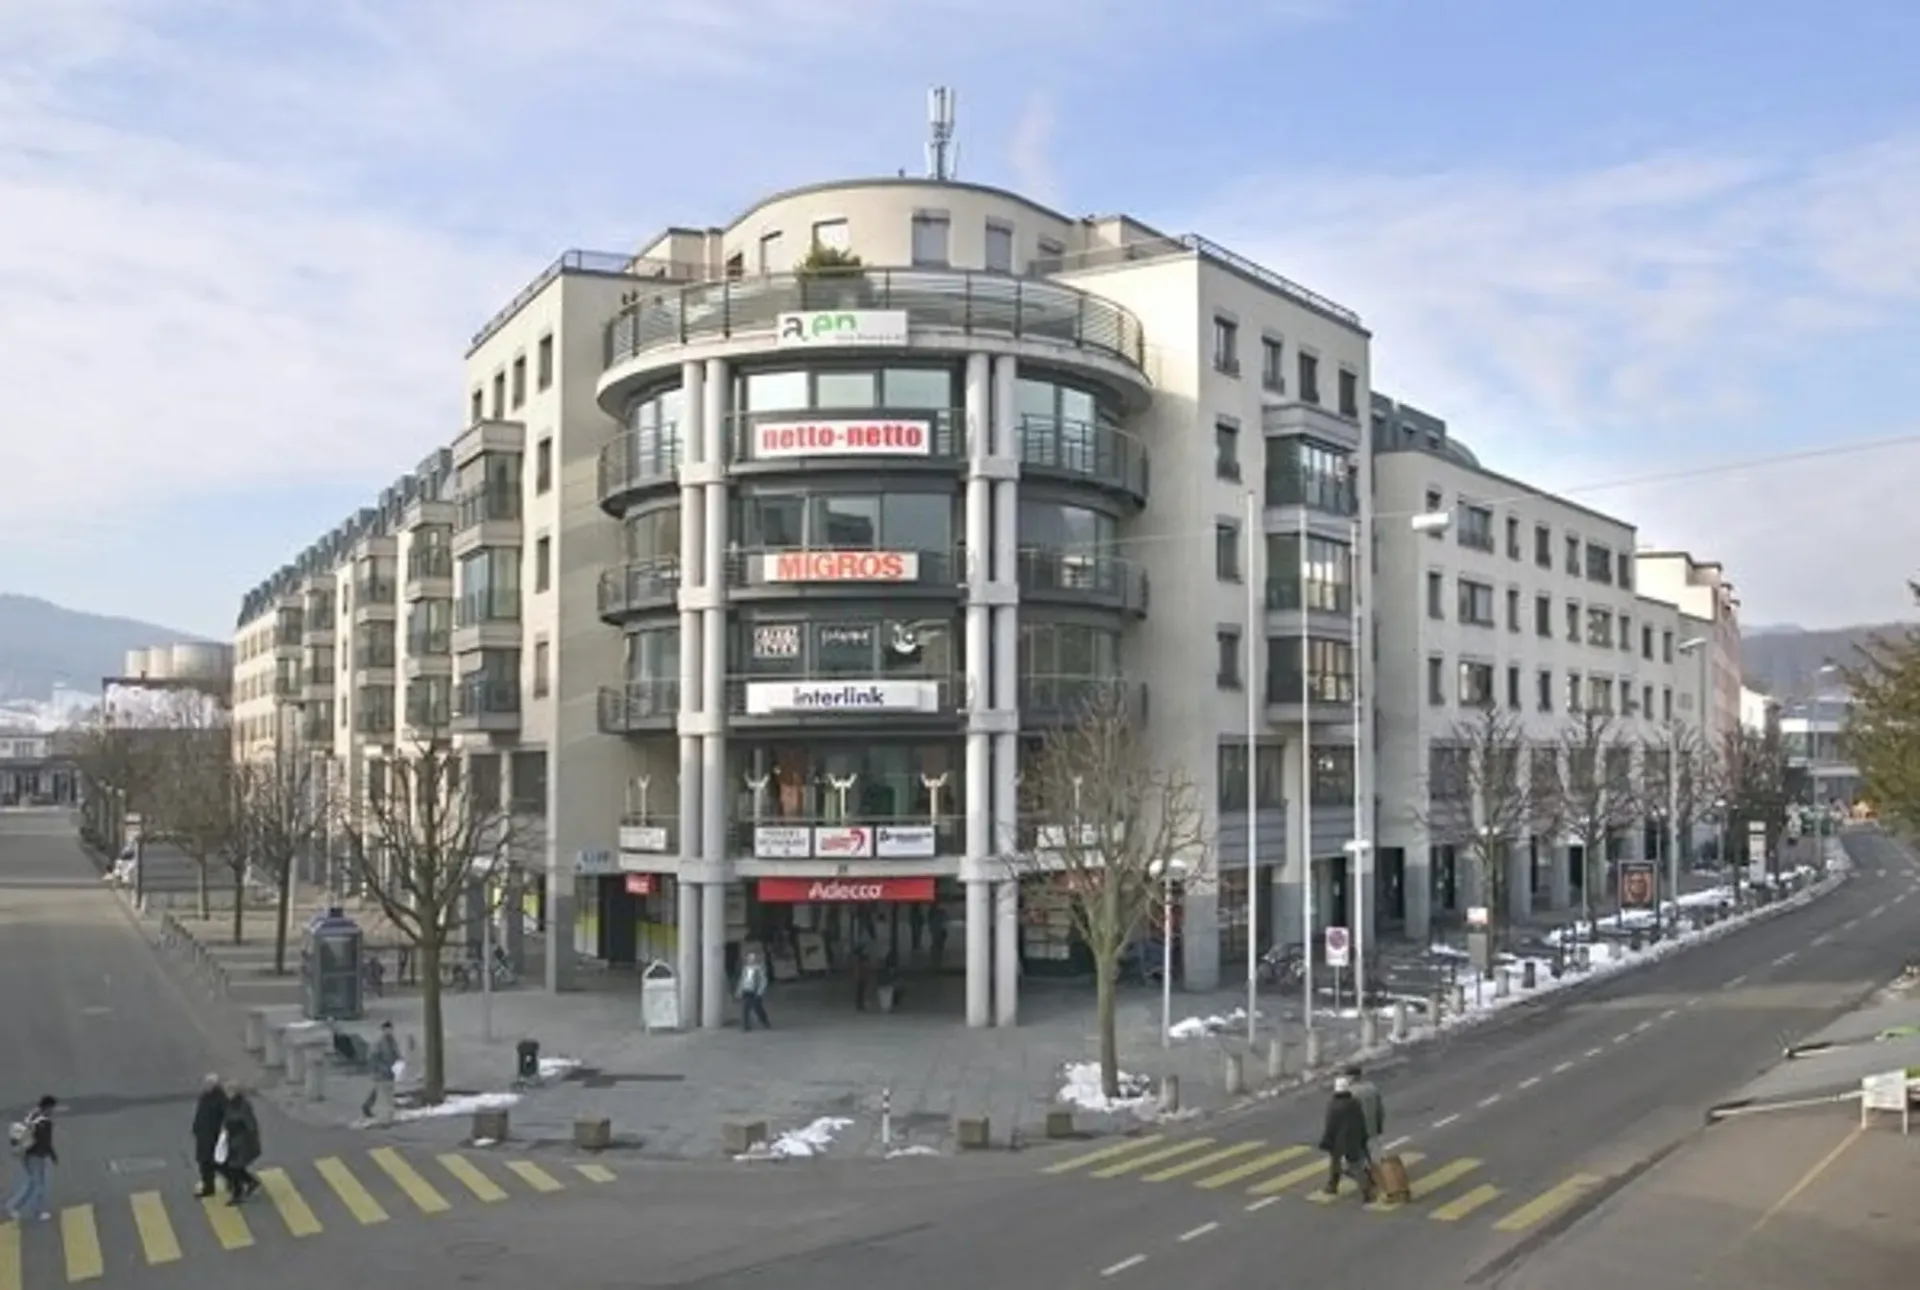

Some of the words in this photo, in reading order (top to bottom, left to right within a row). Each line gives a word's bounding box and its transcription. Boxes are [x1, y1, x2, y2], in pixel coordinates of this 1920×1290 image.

[763, 425, 923, 449] netto-netto
[777, 554, 904, 578] MIGROS
[793, 687, 884, 706] interlink
